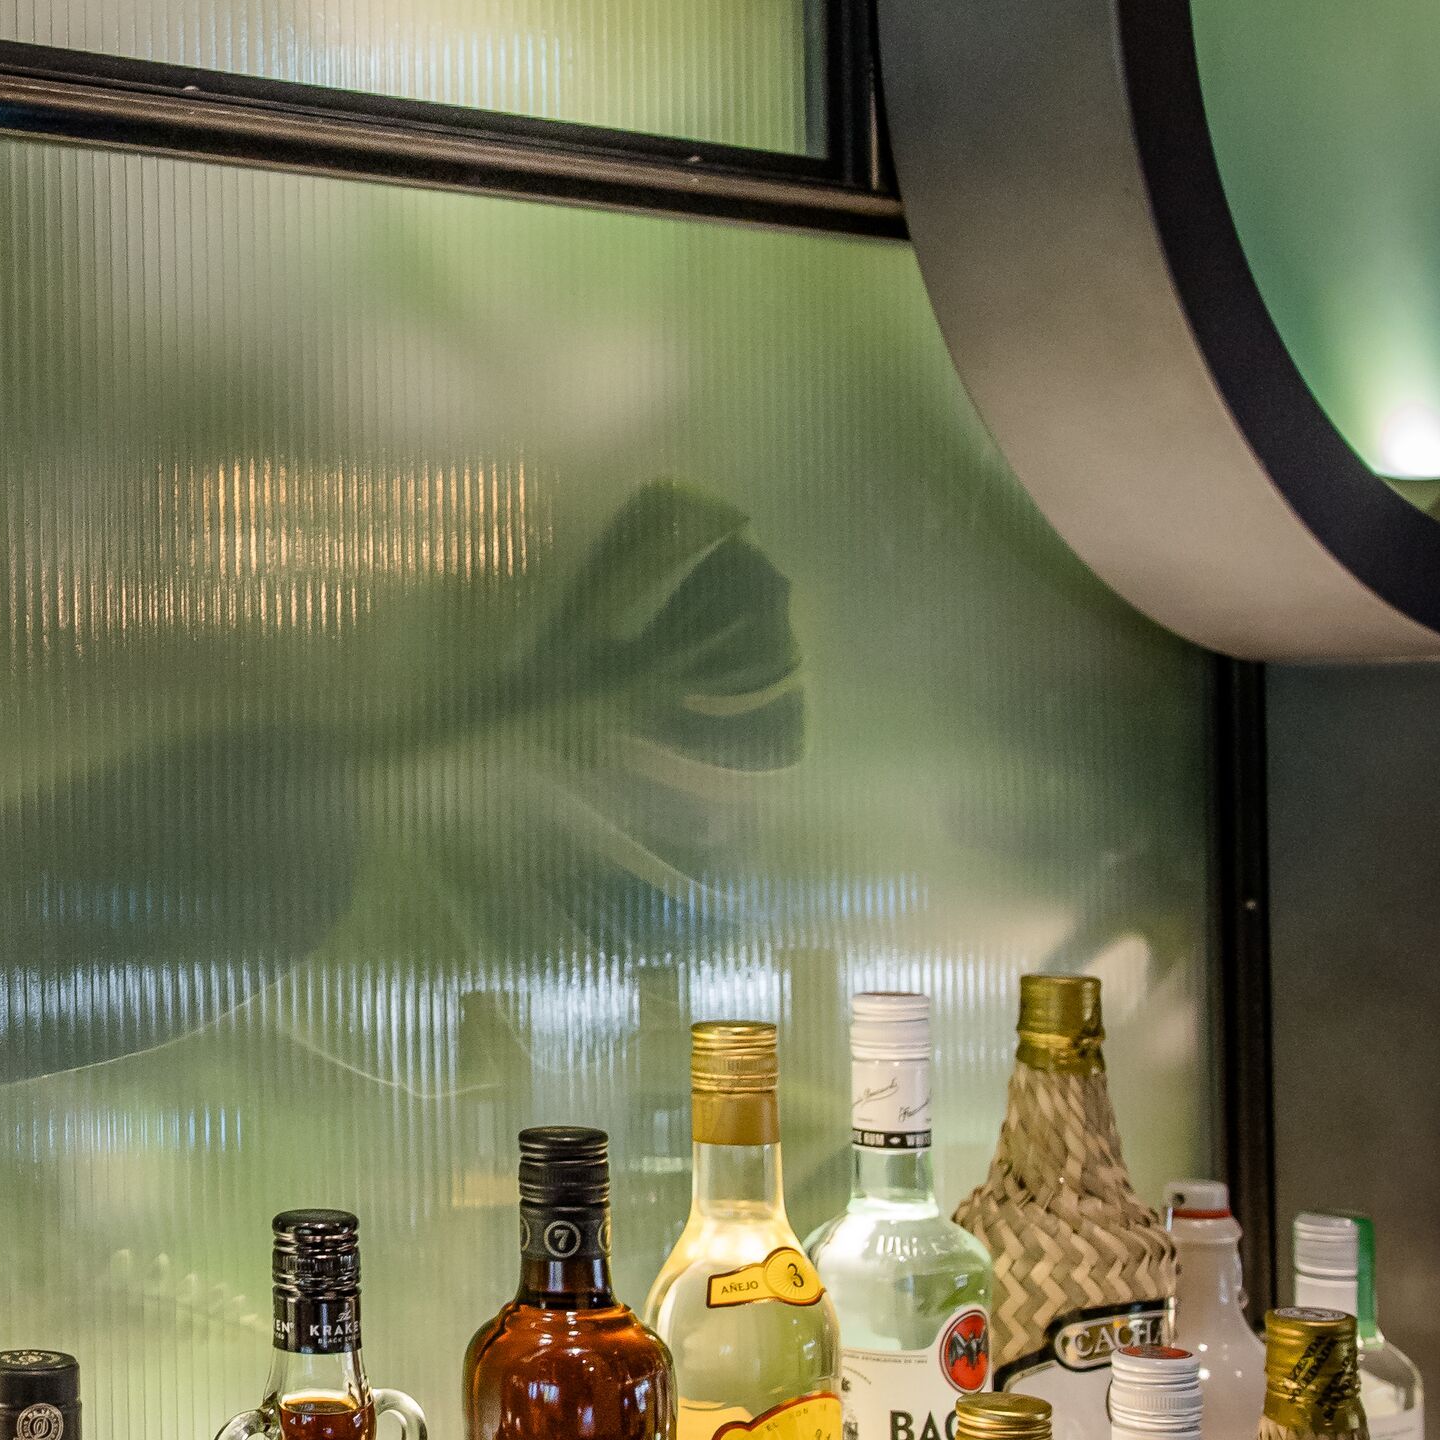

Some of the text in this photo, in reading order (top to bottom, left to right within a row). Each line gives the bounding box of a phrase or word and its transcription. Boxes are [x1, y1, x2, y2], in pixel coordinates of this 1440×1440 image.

[553, 1229, 570, 1251] 7
[787, 1262, 805, 1288] 3
[720, 1279, 759, 1296] AÑEJO
